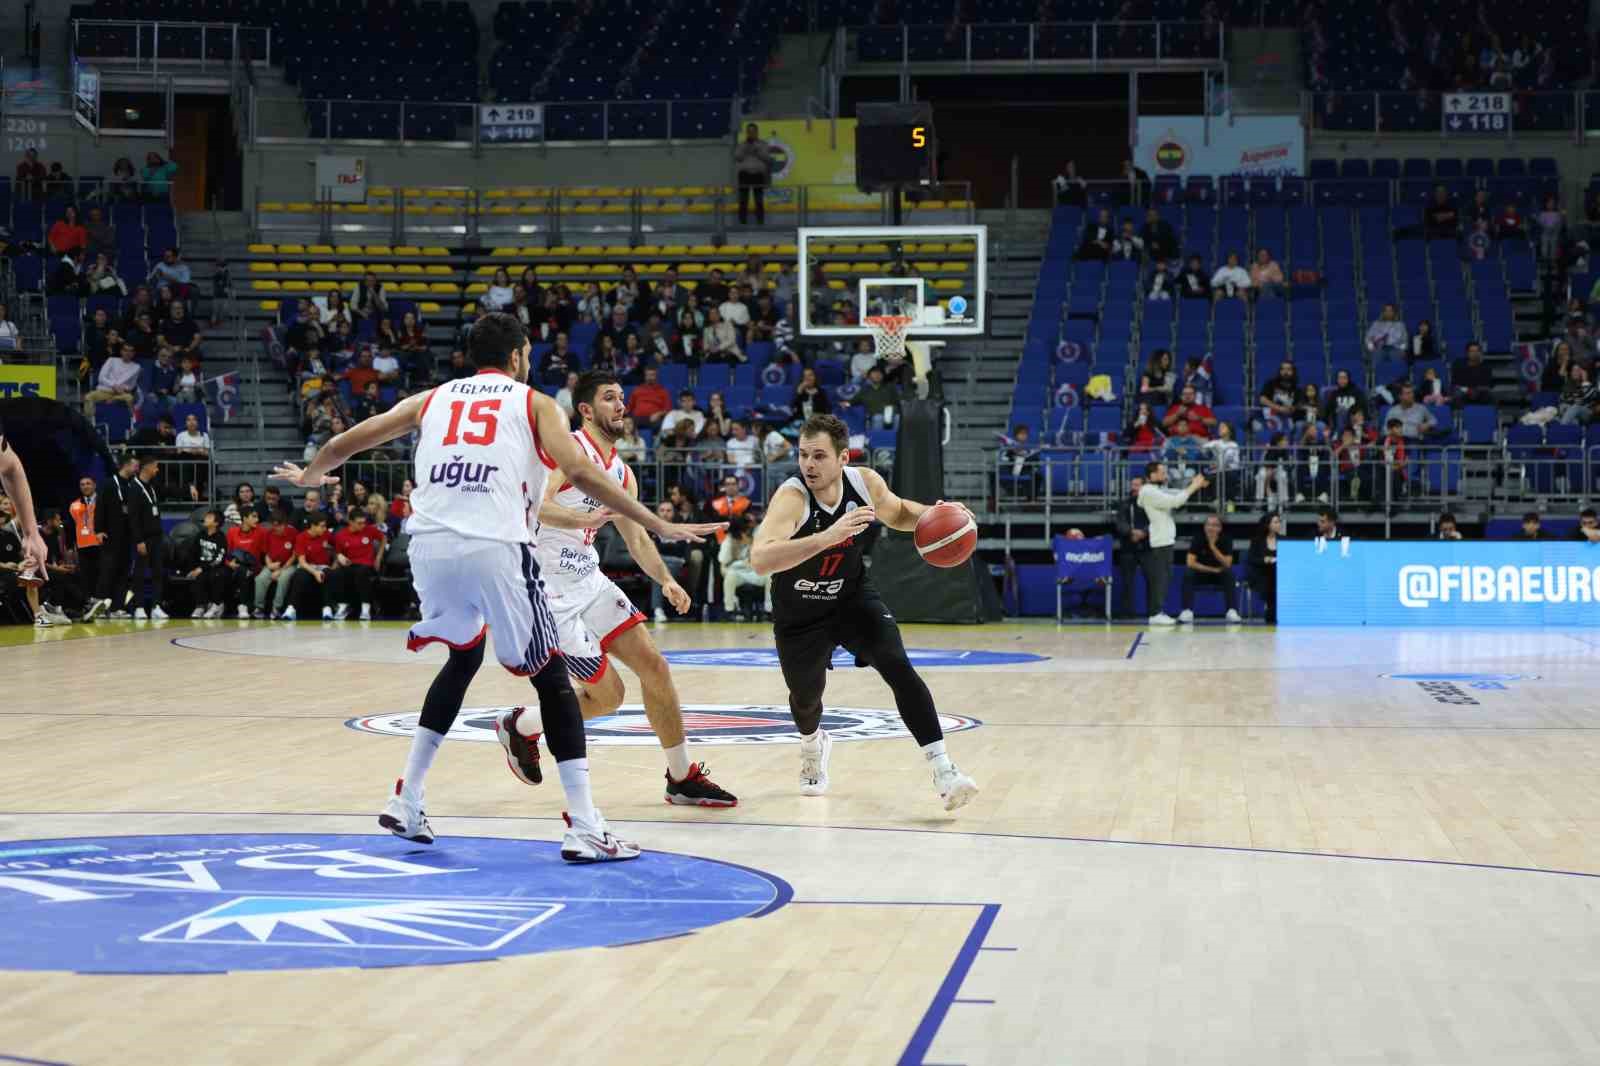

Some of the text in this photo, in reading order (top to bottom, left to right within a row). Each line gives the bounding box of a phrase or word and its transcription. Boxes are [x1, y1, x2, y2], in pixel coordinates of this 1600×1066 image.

[1468, 96, 1504, 110] 218
[507, 108, 535, 121] 219
[1469, 114, 1504, 129] 118
[912, 127, 925, 147] 5
[450, 383, 514, 395] EGEMEN
[442, 399, 502, 446] 15
[430, 455, 499, 488] uğur
[819, 553, 845, 576] 17
